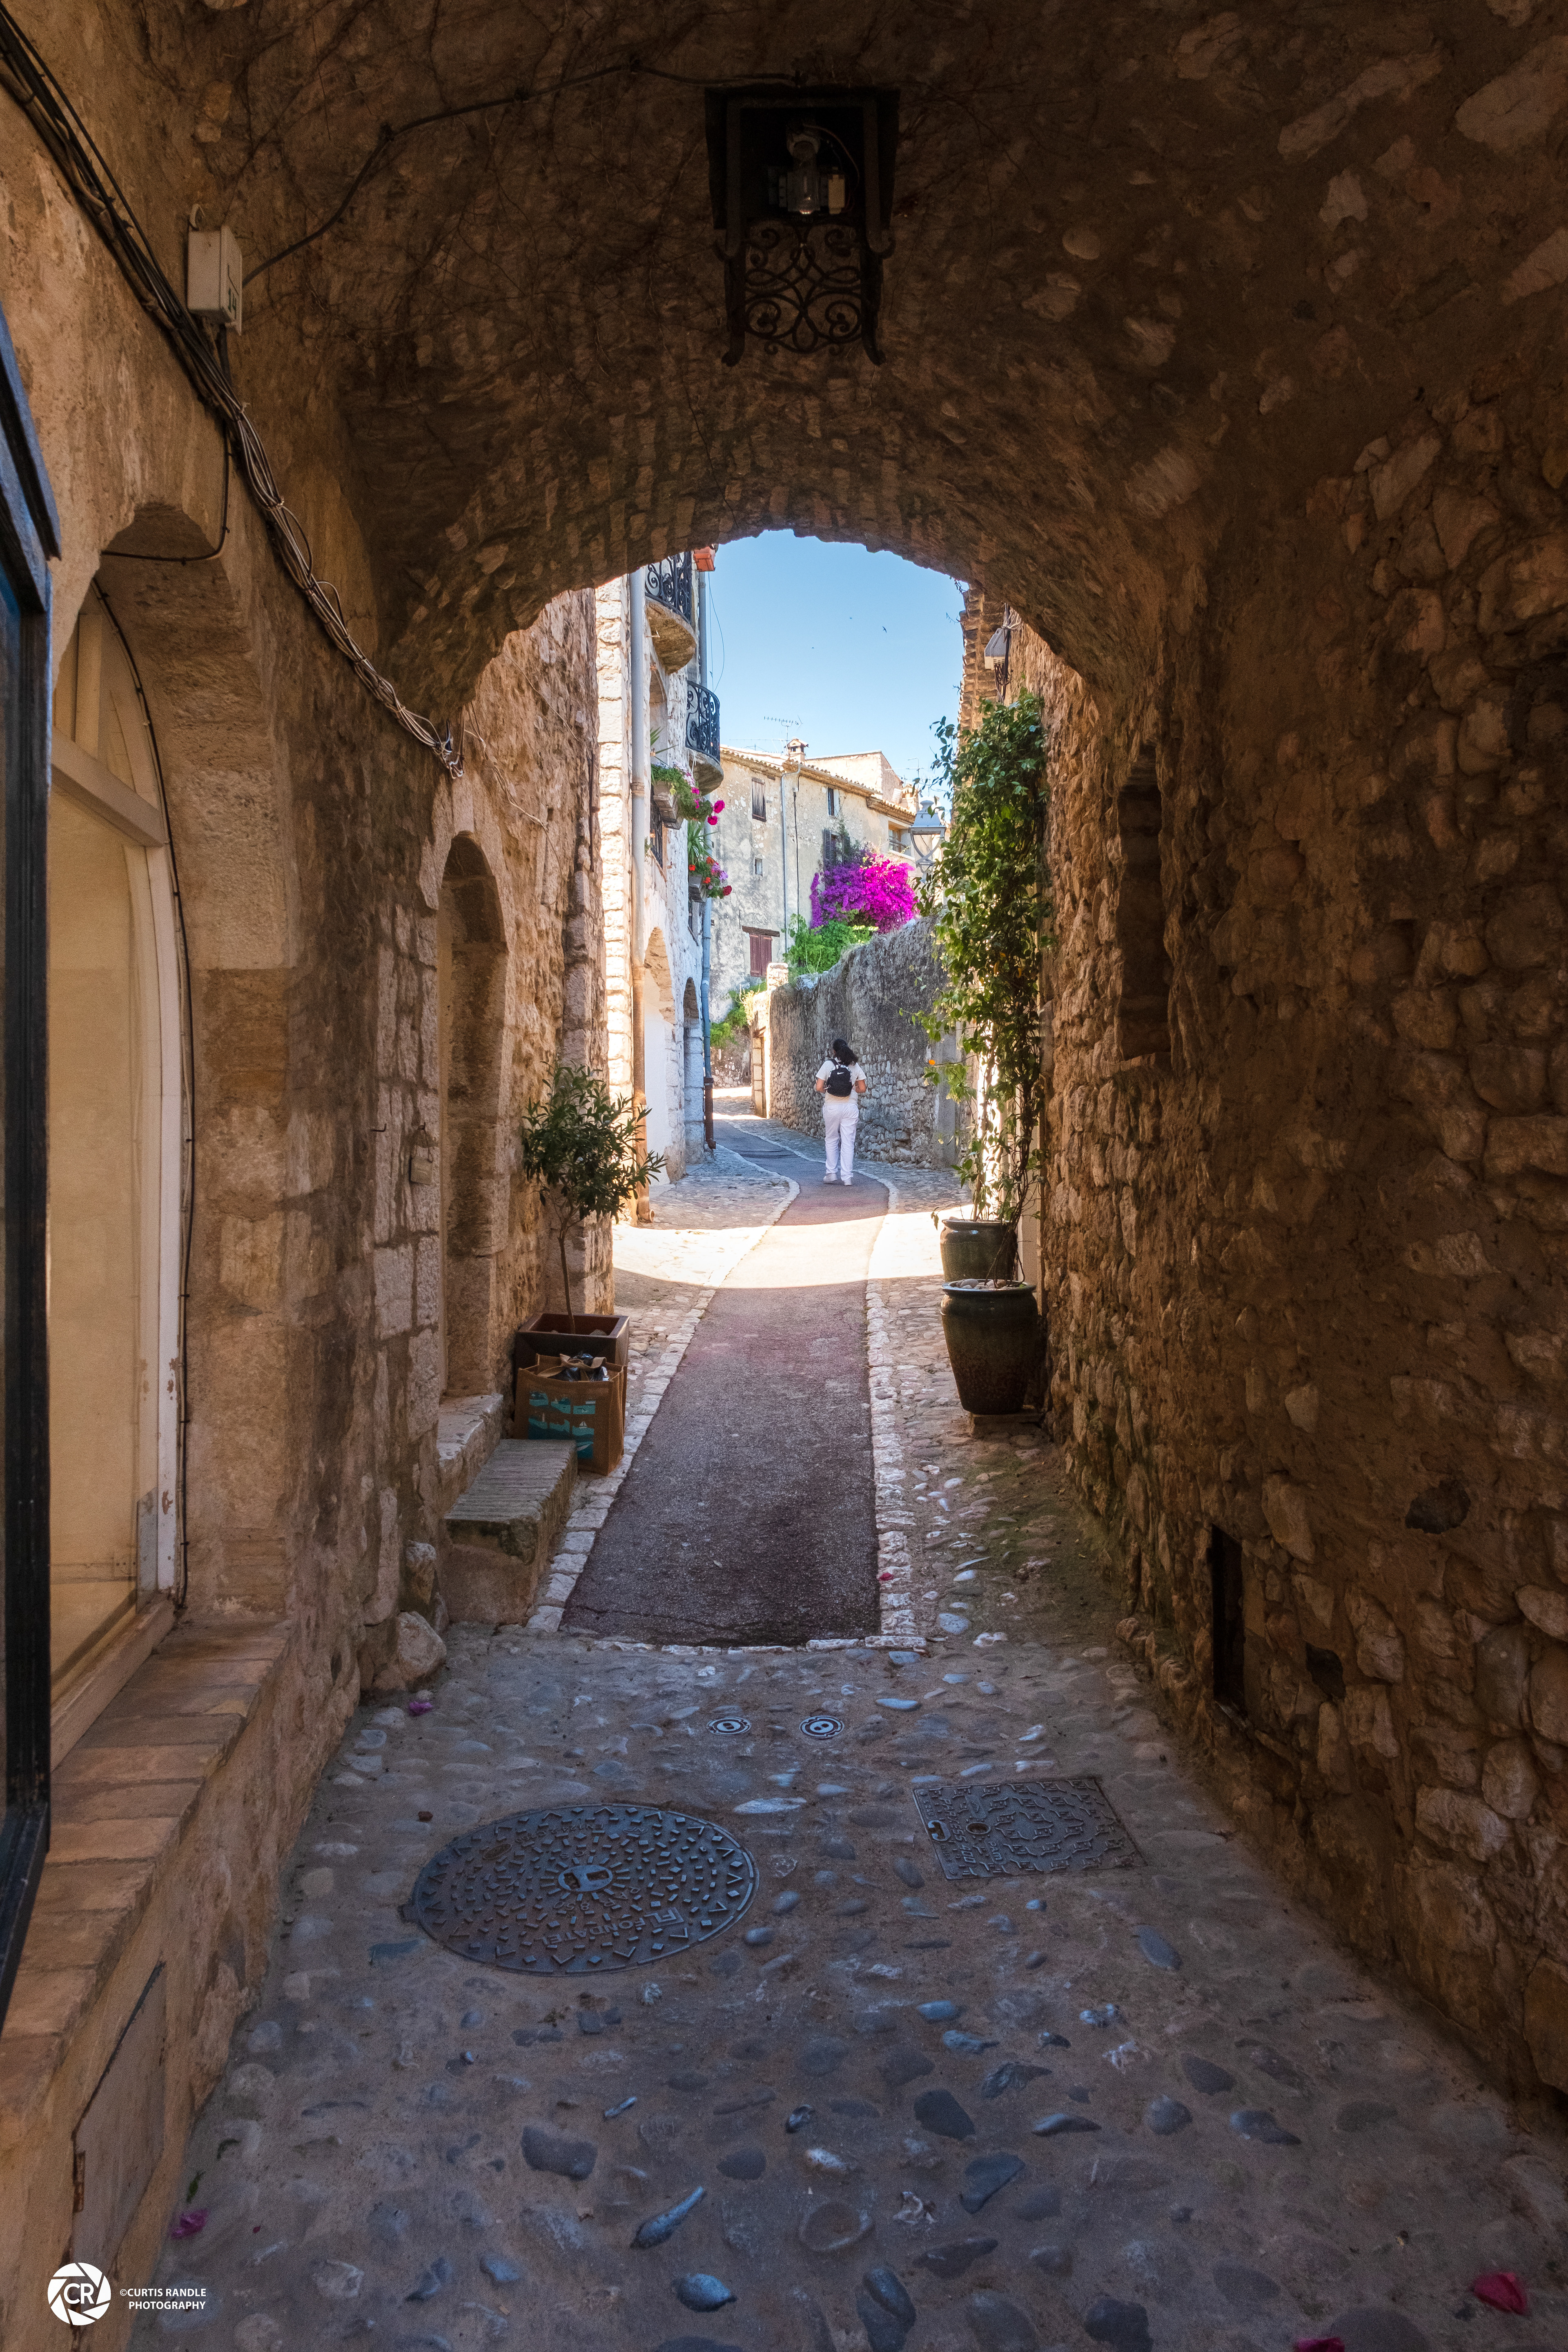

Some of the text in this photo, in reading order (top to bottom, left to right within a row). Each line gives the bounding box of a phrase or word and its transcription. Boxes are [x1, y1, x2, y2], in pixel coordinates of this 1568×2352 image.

[940, 1798, 967, 1842] PARXESS
[960, 1844, 976, 1863] 400
[988, 1841, 1002, 1860] PAM
[554, 1901, 590, 1911] 850
[536, 1918, 646, 1945] FONDATEL
